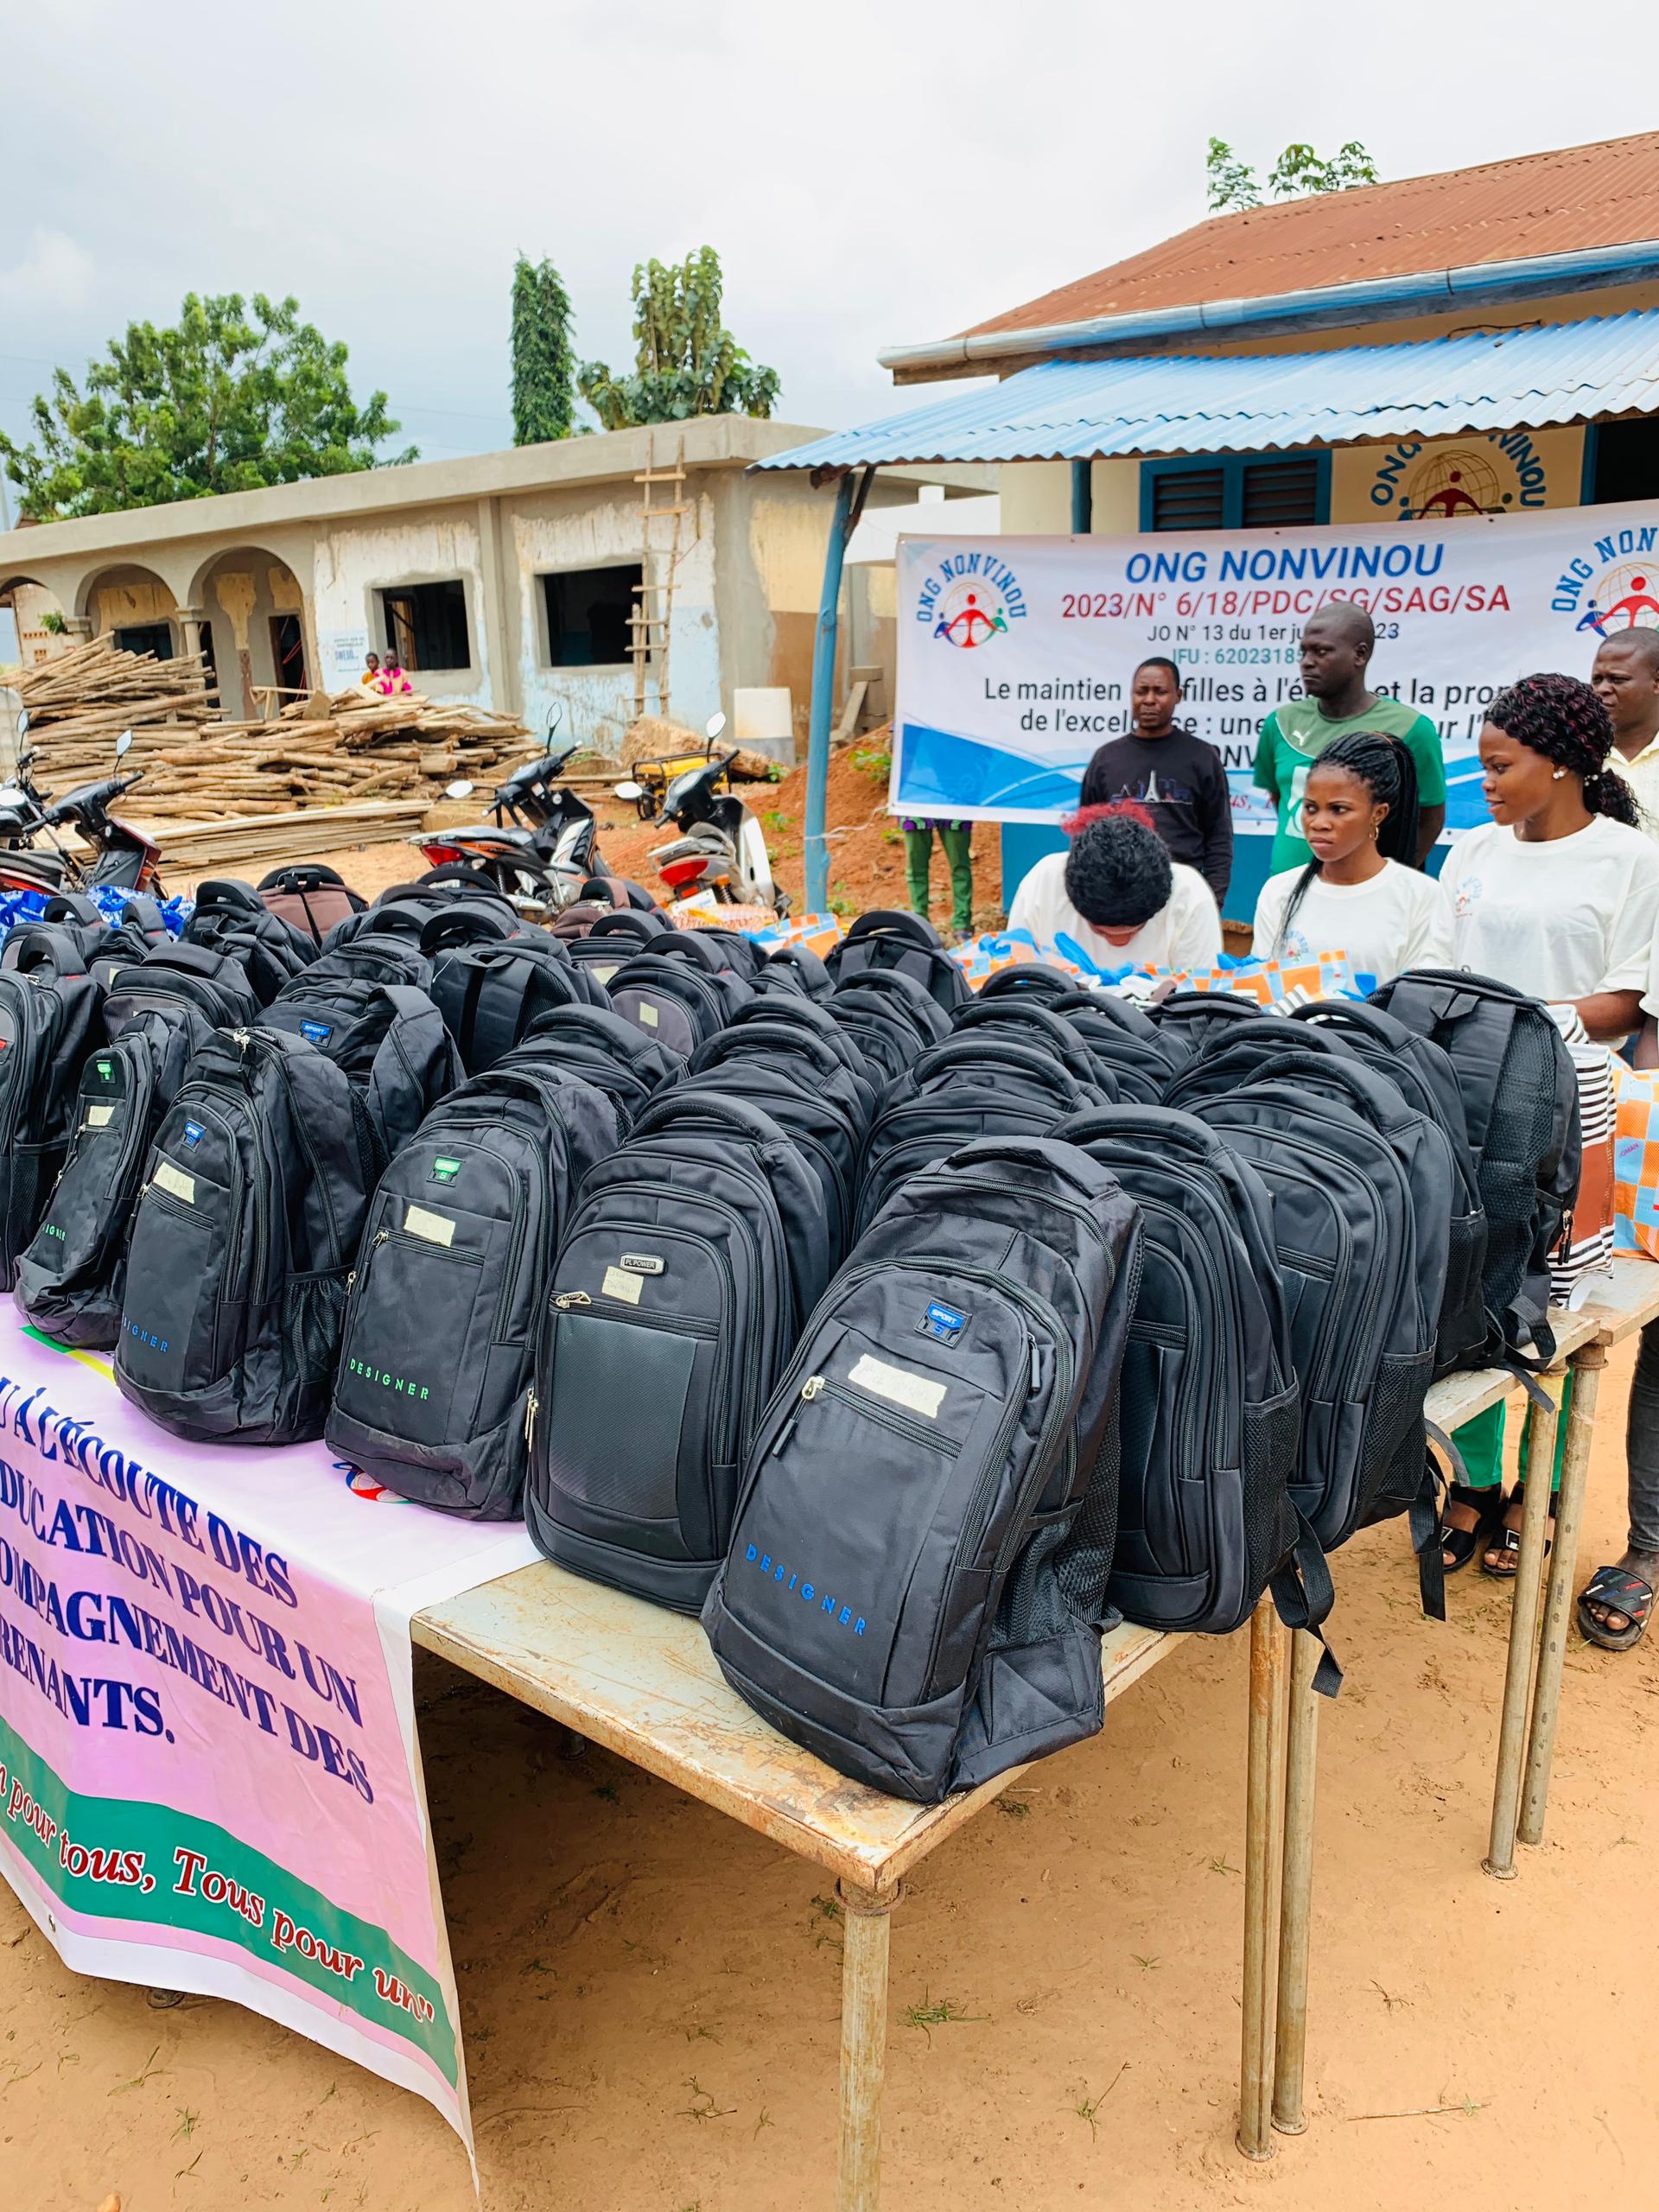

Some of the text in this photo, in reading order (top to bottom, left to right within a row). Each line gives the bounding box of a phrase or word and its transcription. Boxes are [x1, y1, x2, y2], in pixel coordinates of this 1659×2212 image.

[917, 553, 1027, 622] ONG NONVINOU
[1126, 543, 1445, 583] ONG NONVINOU
[1551, 527, 1658, 612] ONG NON
[1147, 626, 1171, 641] JO
[1203, 626, 1224, 640] 13
[1230, 624, 1251, 640] du
[1258, 625, 1287, 640] 1er
[985, 677, 1010, 700] Le
[1018, 677, 1122, 701] maintien
[1183, 677, 1244, 702] filles
[1253, 677, 1267, 702] à
[1411, 678, 1434, 704] la
[1021, 709, 1047, 731] de
[1221, 717, 1265, 735] une
[633, 1259, 655, 1268] POWER
[931, 1308, 957, 1325] SPORT
[349, 1357, 429, 1401] DESIGNER
[0, 1458, 365, 1728] DUCATION POUR UN
[207, 1511, 300, 1609] DES
[746, 1542, 868, 1638] DESIGNER
[0, 1536, 374, 1805] OMPAGNEMENT DES
[0, 1611, 175, 1745] RENANTS.
[7, 1776, 57, 1848] pour
[60, 1831, 158, 1894] tous,
[172, 1847, 264, 1926] Tous
[270, 1908, 365, 1984] pour
